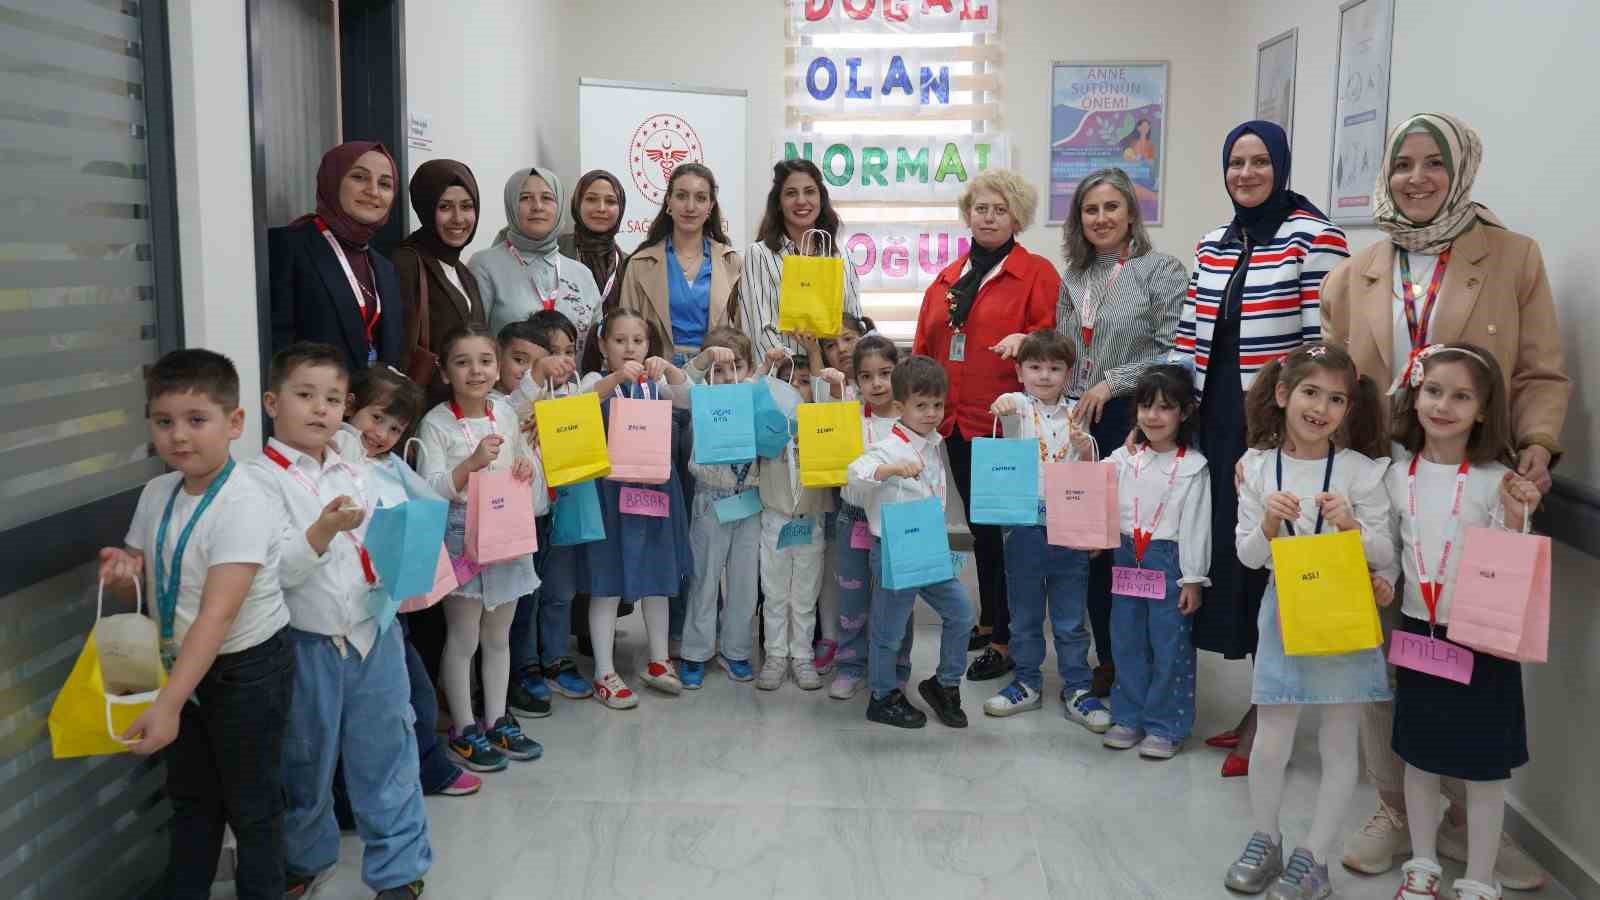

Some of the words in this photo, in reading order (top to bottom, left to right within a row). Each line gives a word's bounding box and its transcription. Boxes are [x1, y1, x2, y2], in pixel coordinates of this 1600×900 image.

[806, 56, 950, 104] OLAN
[1087, 68, 1127, 80] ANNE
[626, 217, 650, 233] SAĞ
[847, 232, 972, 277] OĞU
